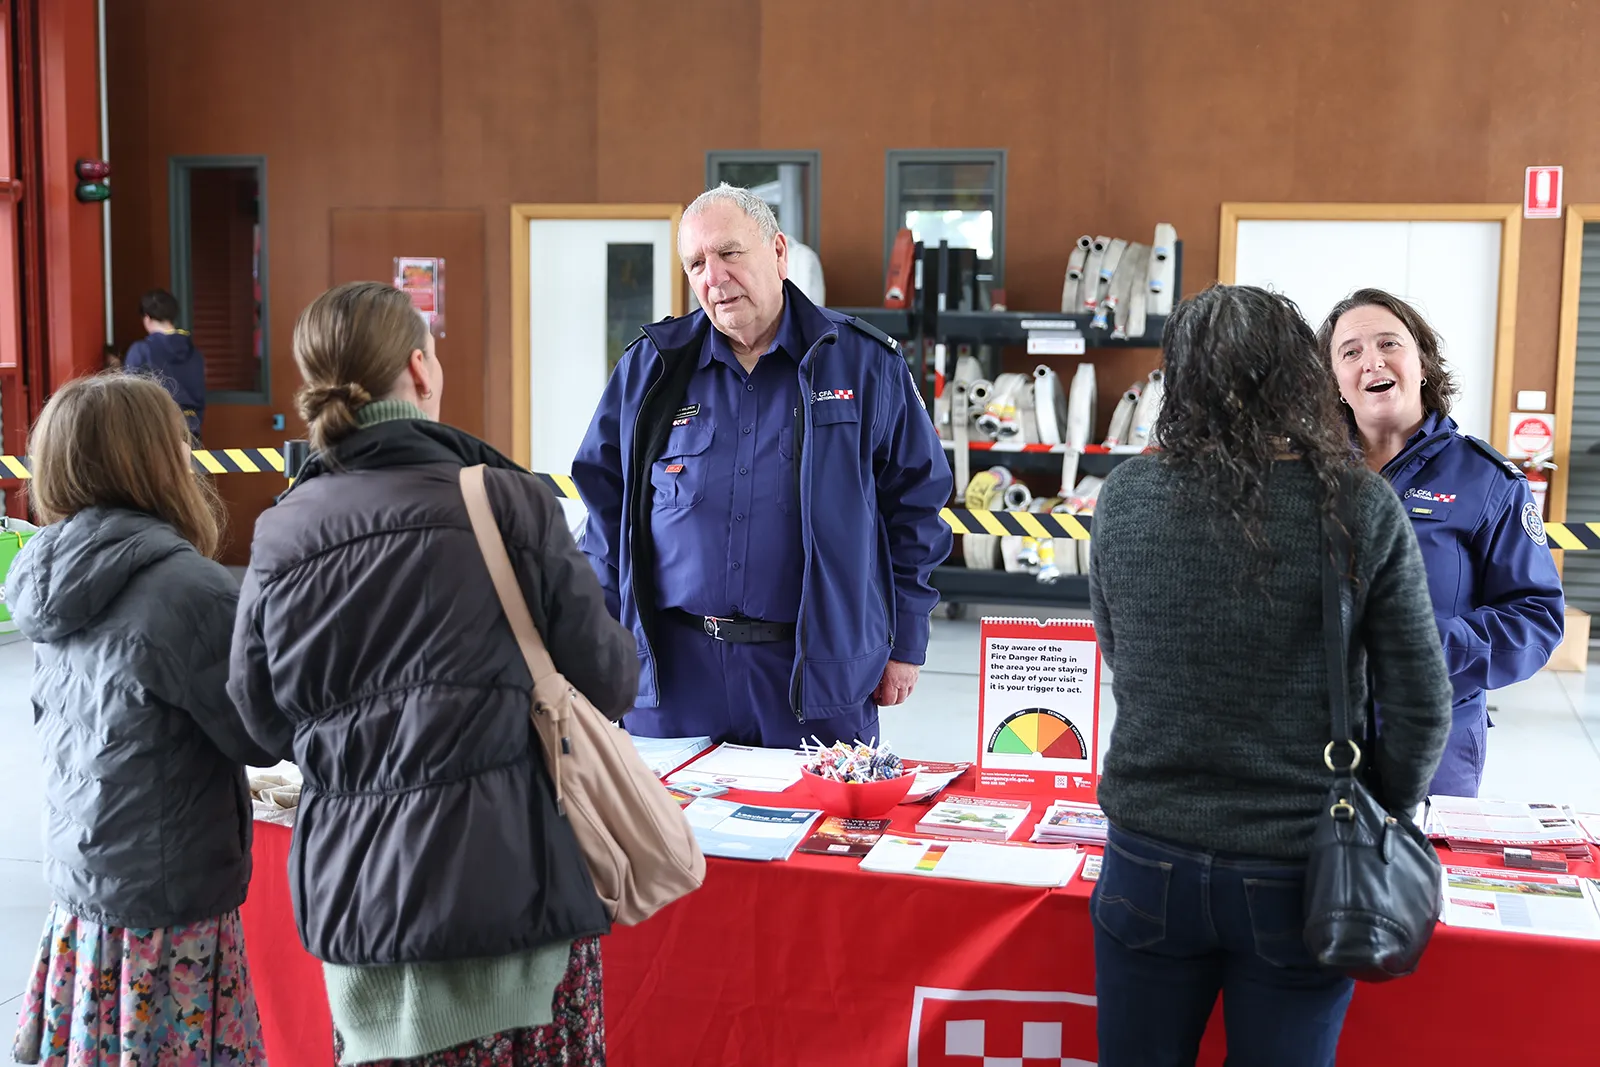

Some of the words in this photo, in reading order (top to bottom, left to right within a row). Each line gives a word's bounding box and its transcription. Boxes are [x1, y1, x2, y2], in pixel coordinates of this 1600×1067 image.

[1416, 489, 1432, 497] CFA
[991, 643, 1010, 652] Stay
[1048, 645, 1062, 653] the
[991, 652, 1007, 660] Fire
[1008, 653, 1038, 663] Danger
[1040, 654, 1067, 664] Rating
[1069, 655, 1077, 663] in
[1025, 665, 1041, 673] you
[1057, 666, 1088, 675] staying
[1011, 673, 1027, 682] day
[1058, 675, 1076, 683] visit
[989, 682, 996, 690] it
[997, 682, 1005, 690] is
[1027, 684, 1054, 694] trigger
[737, 812, 769, 821] Leaving
